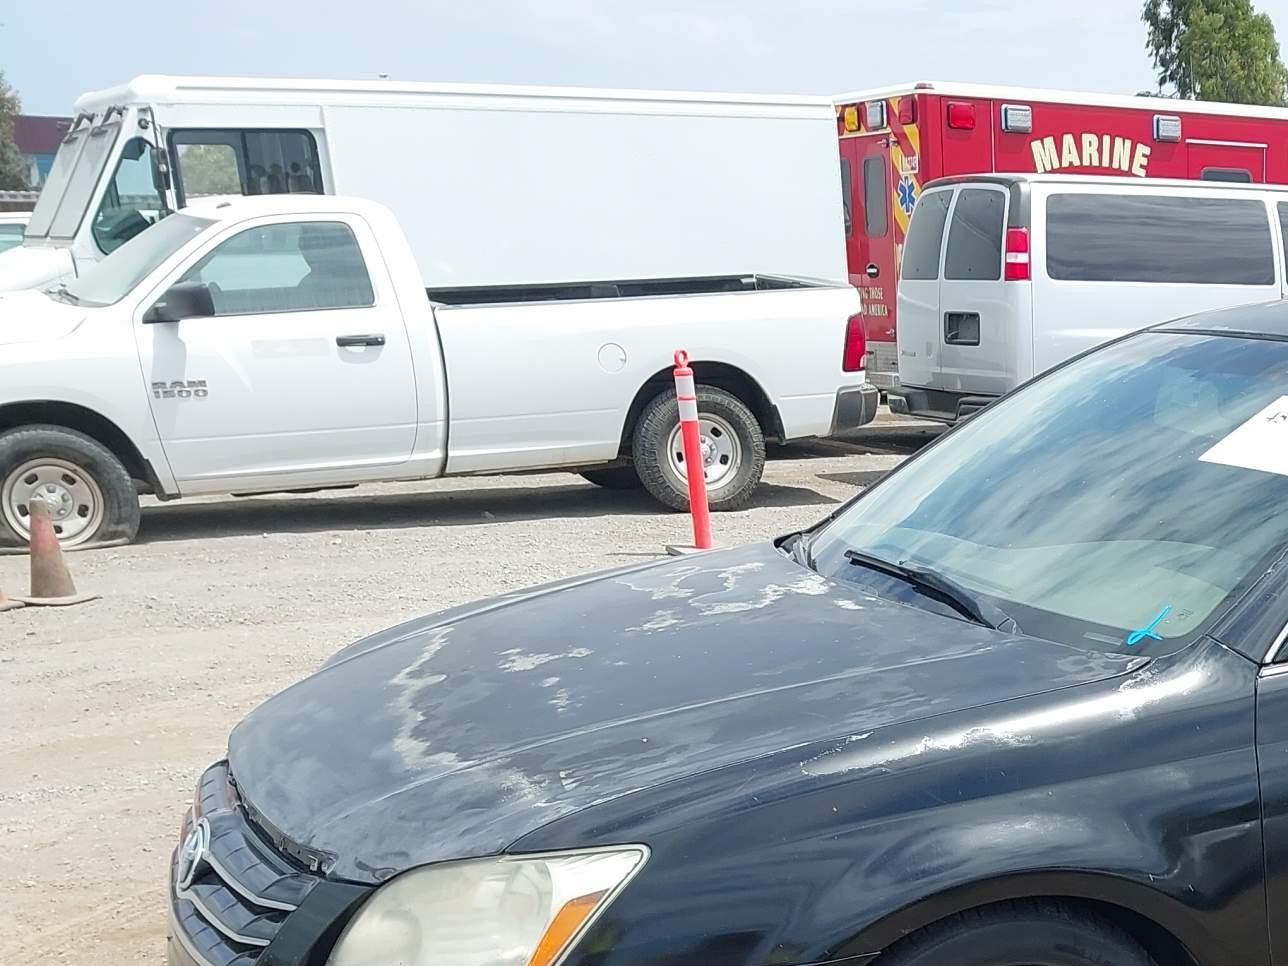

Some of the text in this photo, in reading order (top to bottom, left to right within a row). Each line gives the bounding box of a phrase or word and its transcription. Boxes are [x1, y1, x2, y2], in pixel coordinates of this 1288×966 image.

[1030, 133, 1151, 178] MARINE
[869, 287, 884, 300] THOSE
[151, 380, 207, 390] RAM
[153, 389, 208, 399] 1500
